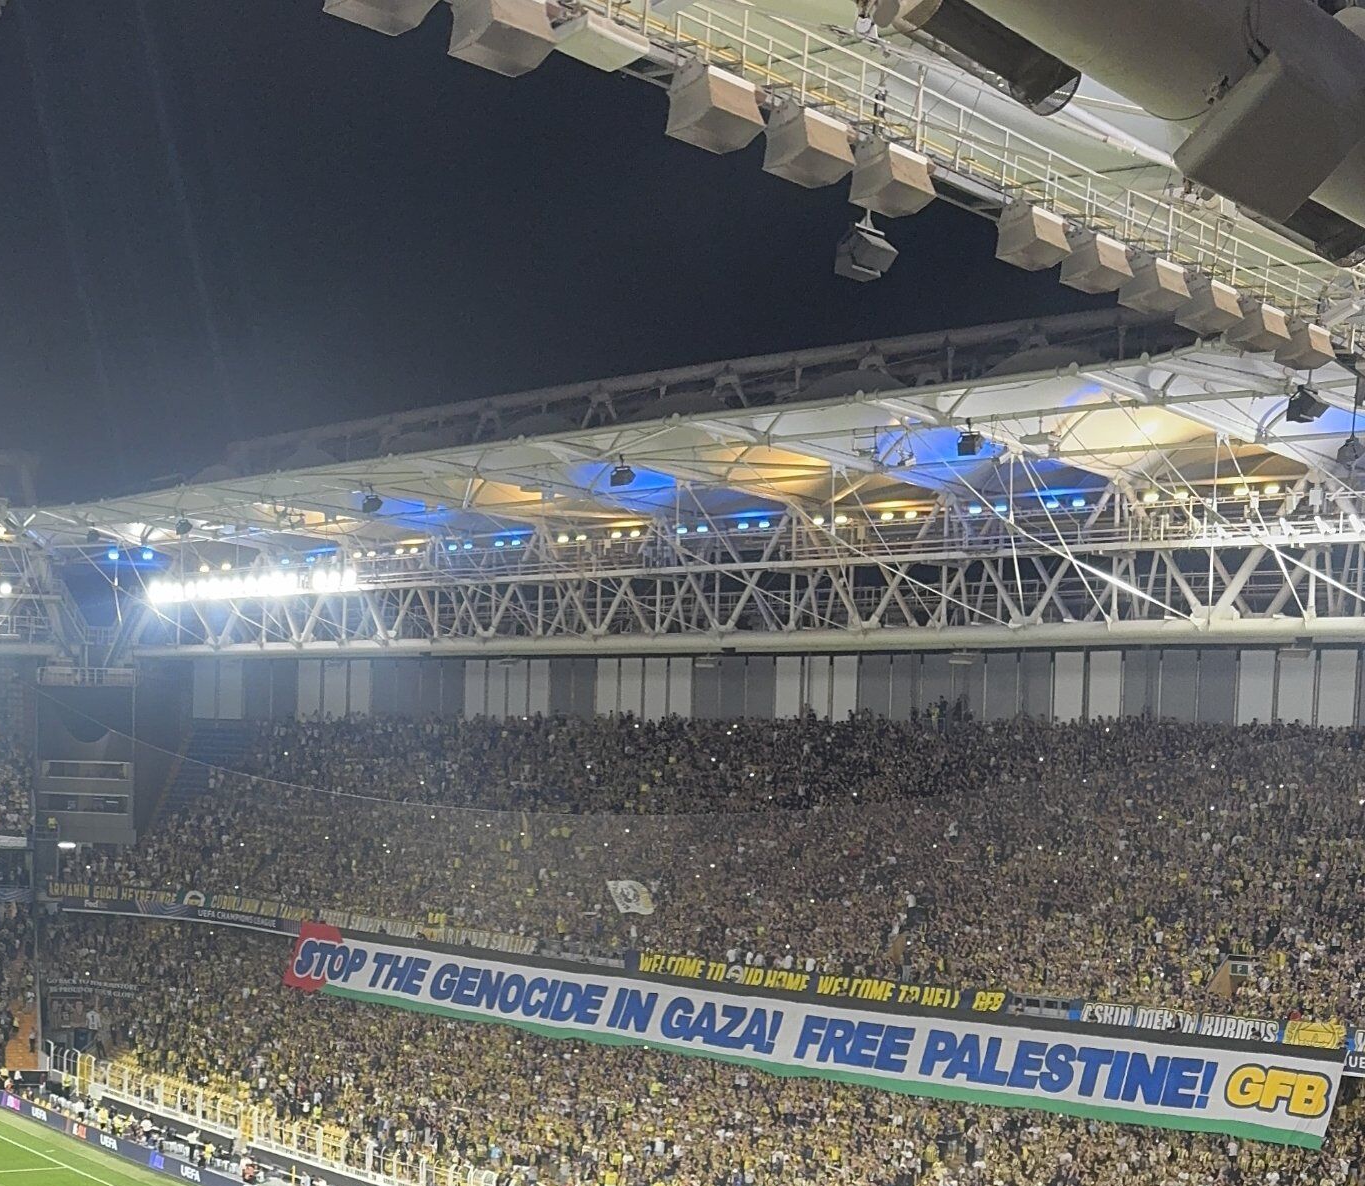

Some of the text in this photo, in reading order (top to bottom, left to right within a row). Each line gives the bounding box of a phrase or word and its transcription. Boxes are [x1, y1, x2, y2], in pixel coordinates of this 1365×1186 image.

[293, 937, 368, 983] STOP
[369, 952, 423, 995] THE
[430, 962, 607, 1032] GENOCIDE
[607, 988, 659, 1033] IN
[660, 997, 783, 1054] GAZA!
[794, 1015, 915, 1073] FREE
[919, 1030, 1219, 1109] PALESTINE!
[1226, 1065, 1332, 1118] GFB
[31, 1106, 47, 1121] UEFA
[100, 1134, 118, 1151] UEFA
[180, 1164, 201, 1182] UEFA
